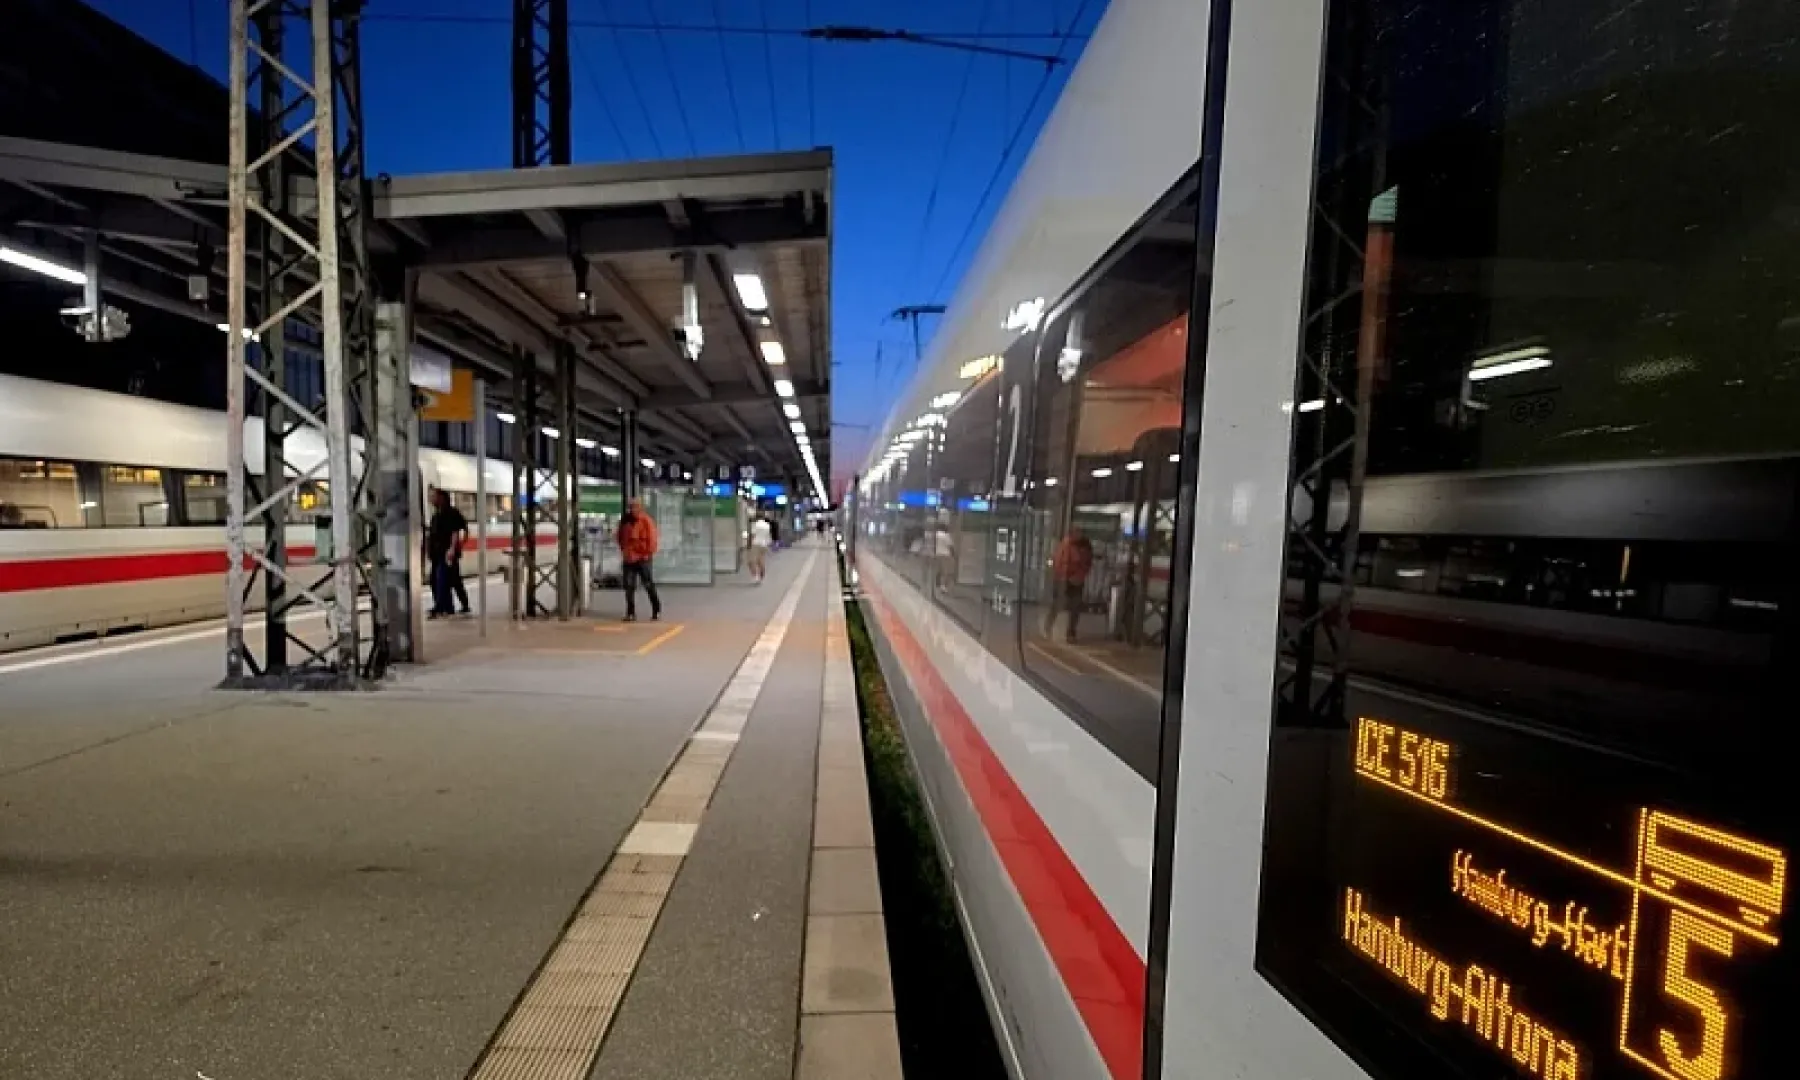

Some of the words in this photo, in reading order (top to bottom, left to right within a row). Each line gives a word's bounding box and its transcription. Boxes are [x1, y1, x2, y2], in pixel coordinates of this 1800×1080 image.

[1003, 383, 1020, 498] 2
[1356, 717, 1395, 778] ICE
[1399, 730, 1450, 799] 516
[1344, 886, 1578, 1080] Hamburg-Altona
[1659, 907, 1734, 1080] 5
